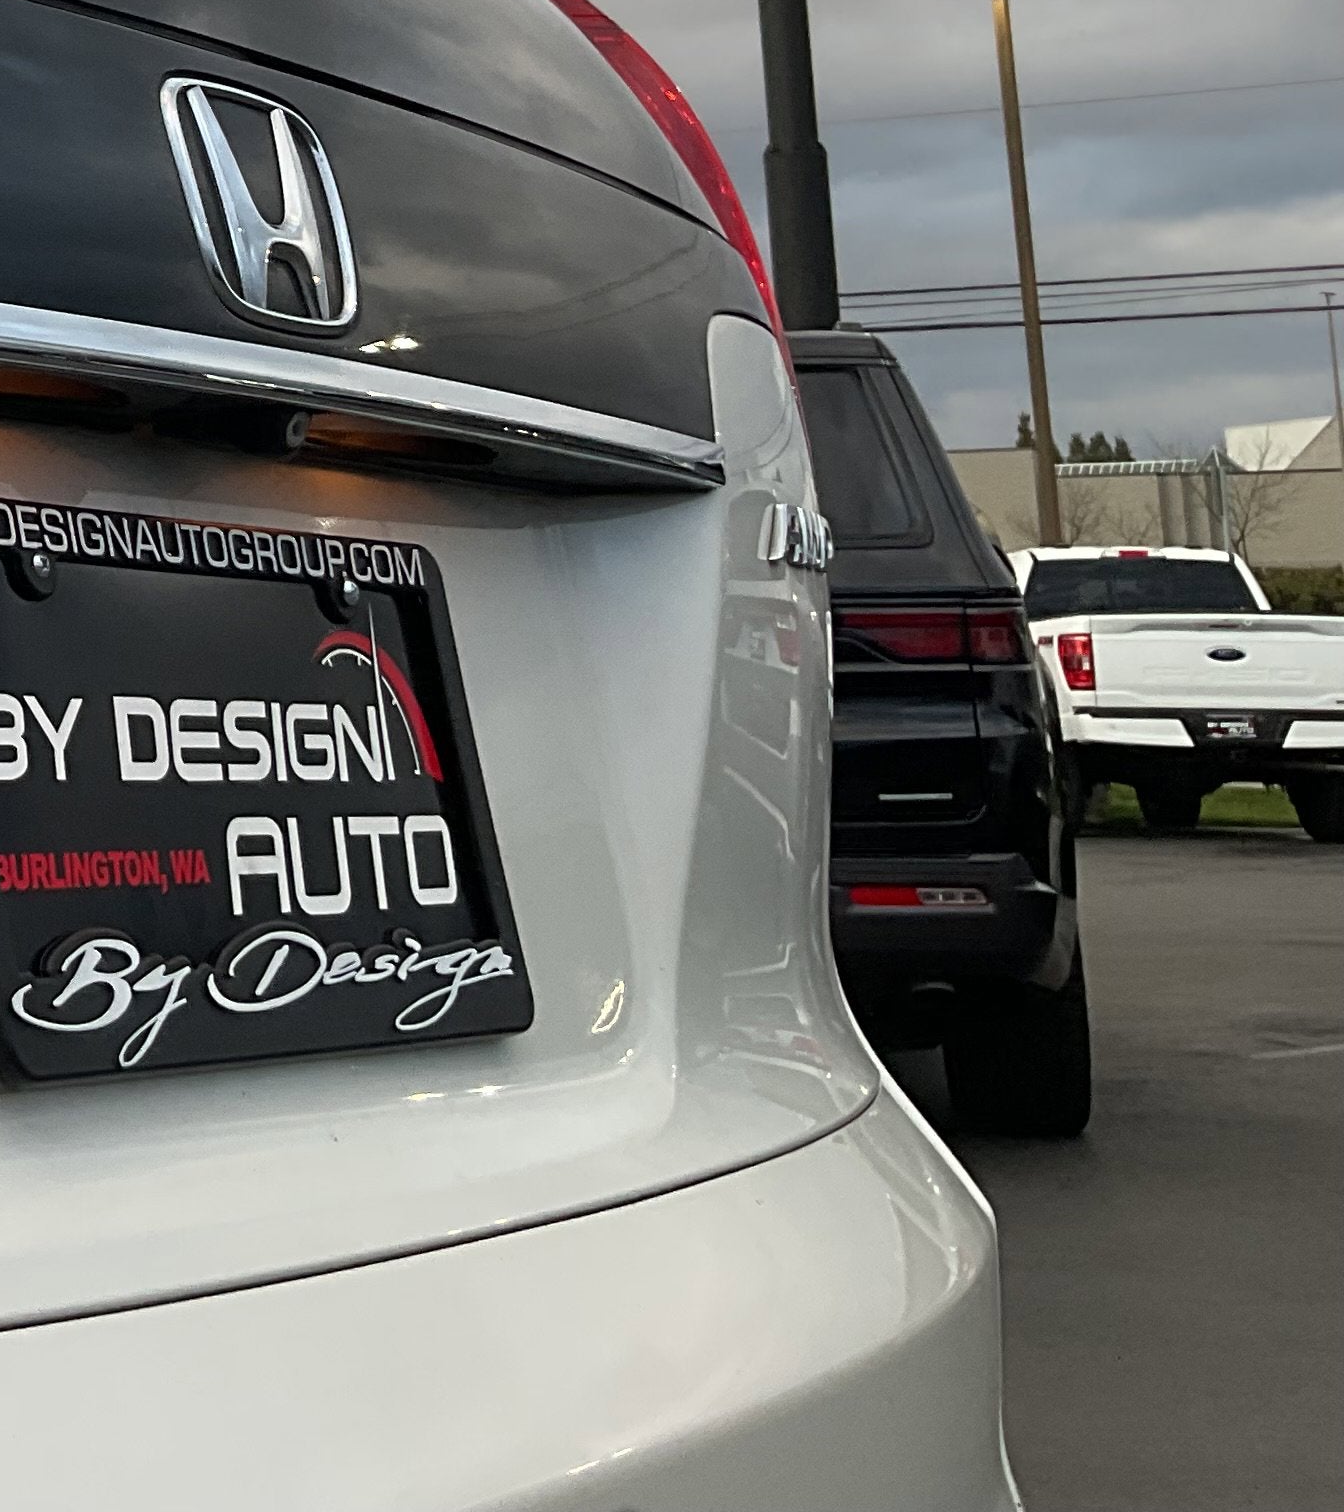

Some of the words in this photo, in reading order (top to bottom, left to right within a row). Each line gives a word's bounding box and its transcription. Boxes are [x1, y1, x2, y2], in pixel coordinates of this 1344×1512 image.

[112, 695, 384, 783] DESIGN
[169, 849, 211, 885] WA
[226, 815, 459, 916] AUTO
[11, 937, 192, 1068] By
[206, 929, 514, 1032] Design
